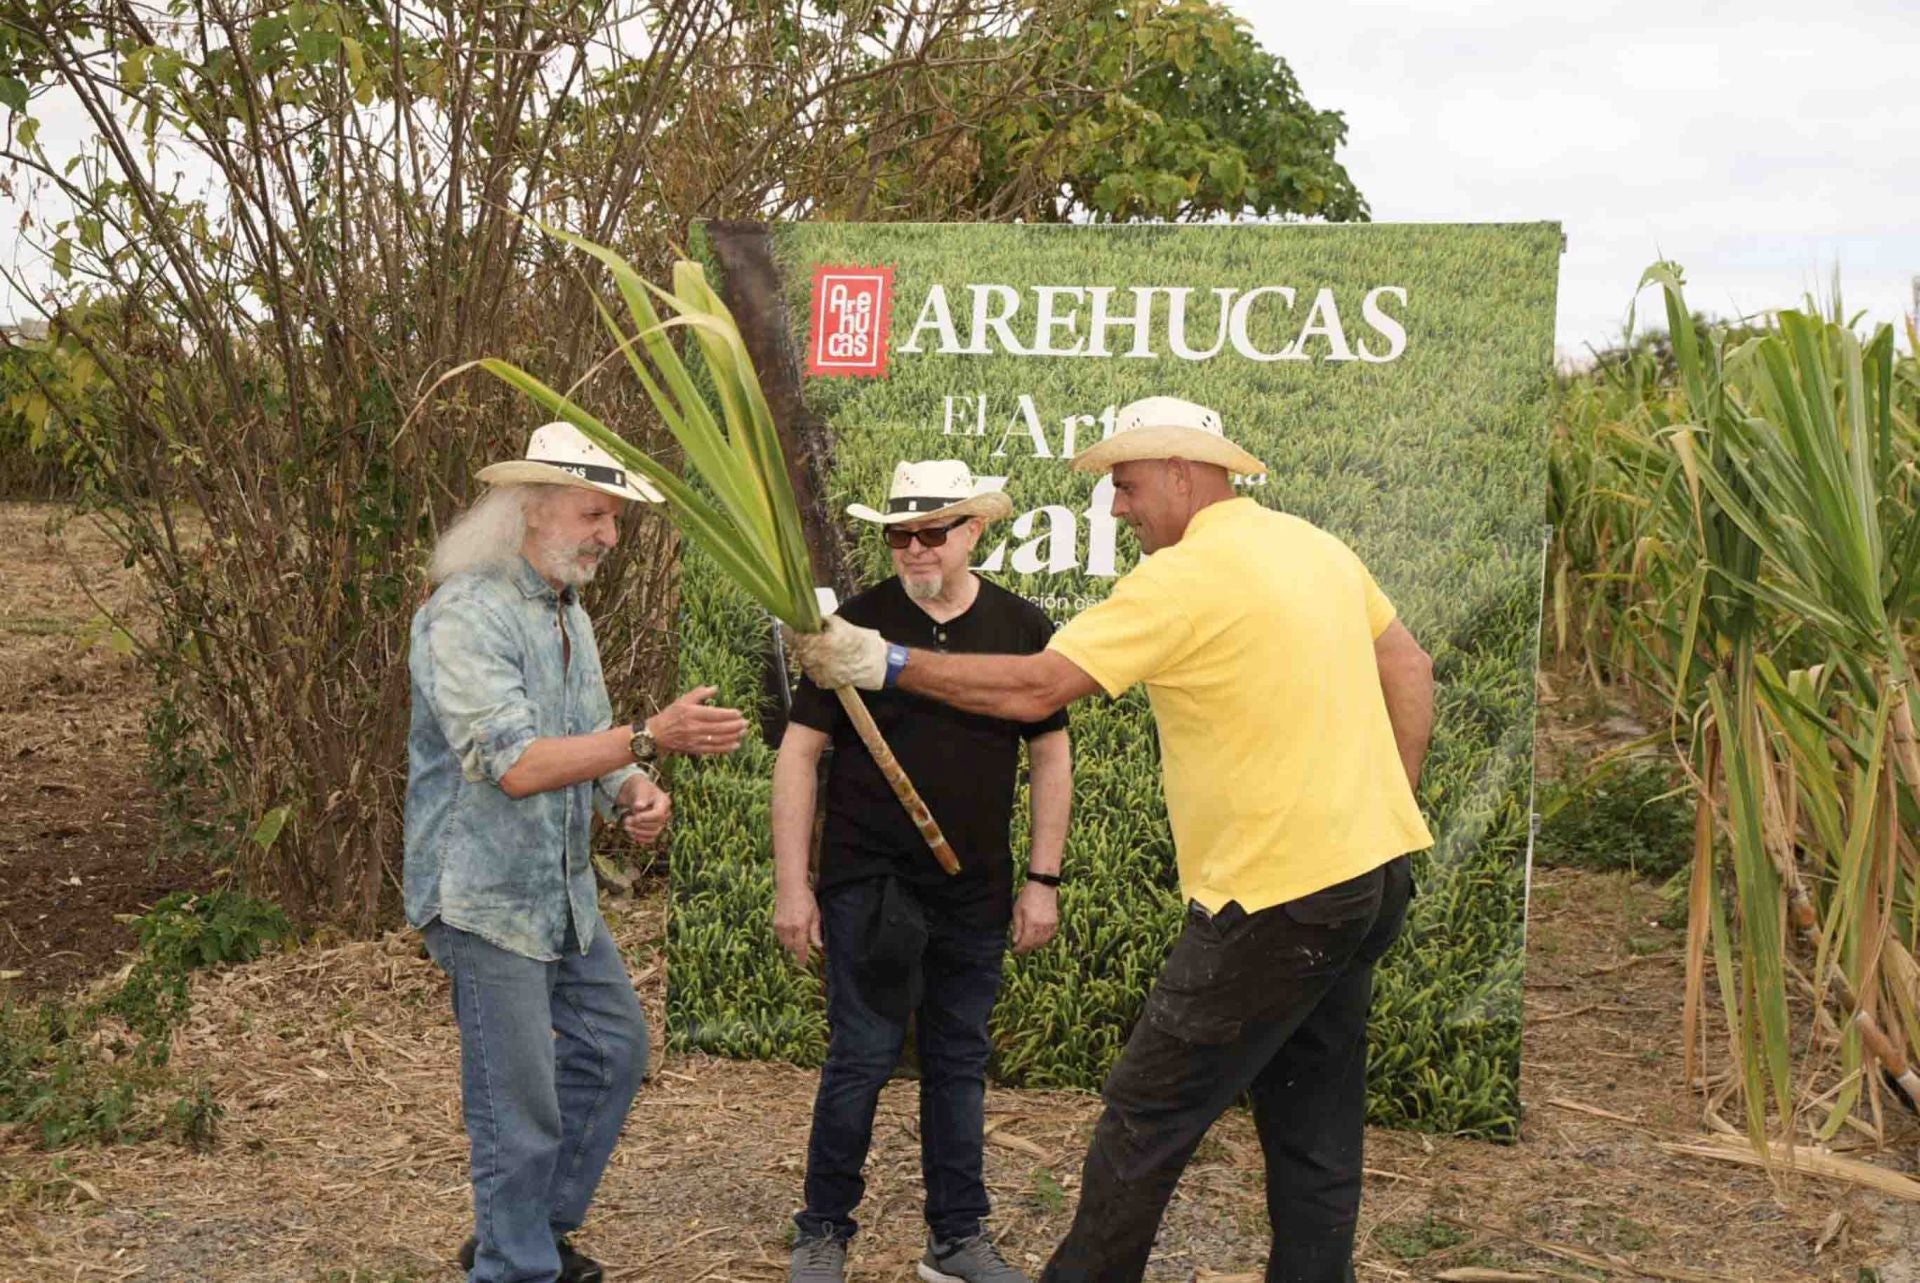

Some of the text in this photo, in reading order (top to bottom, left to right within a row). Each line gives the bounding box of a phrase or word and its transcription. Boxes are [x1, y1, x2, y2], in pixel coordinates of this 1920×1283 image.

[896, 284, 1408, 363] AREHUCAS
[942, 394, 1120, 459] El Art
